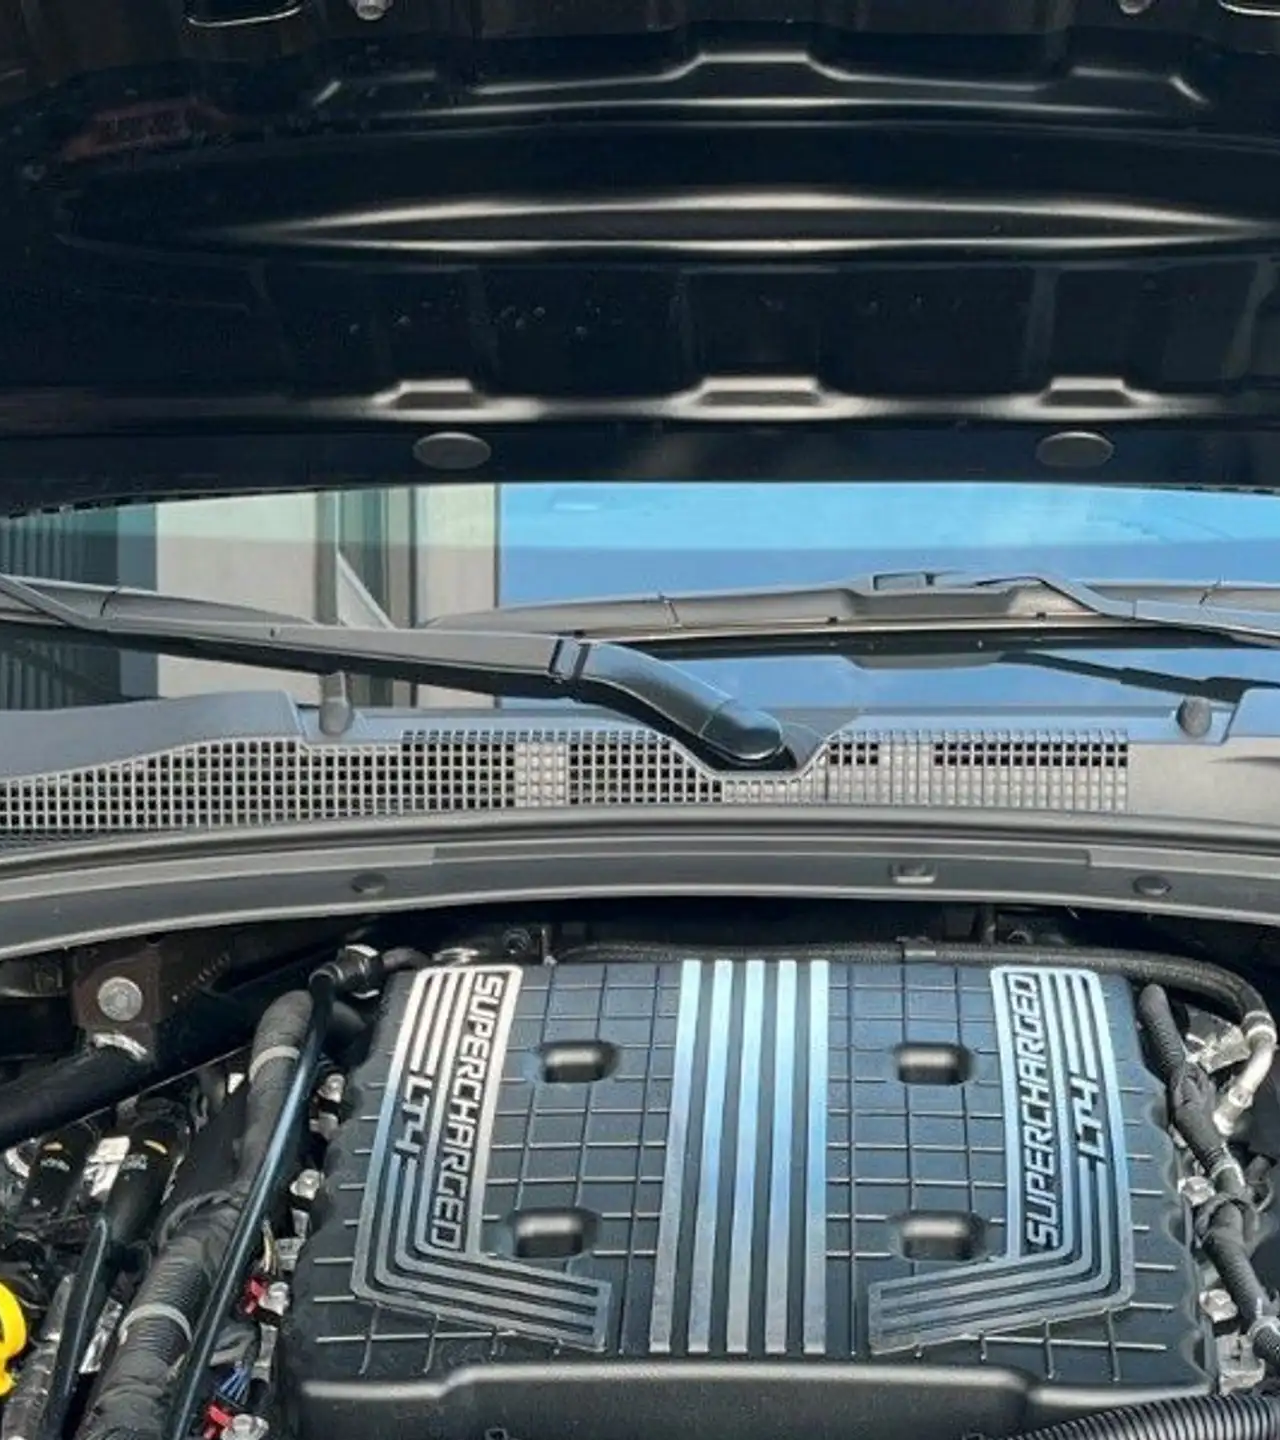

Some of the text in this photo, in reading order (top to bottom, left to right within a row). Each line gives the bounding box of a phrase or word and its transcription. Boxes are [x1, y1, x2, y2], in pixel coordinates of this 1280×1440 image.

[395, 1076, 432, 1153] LT4
[432, 974, 503, 1249] SUPERCHARGED
[1007, 974, 1059, 1249] SUPERCHARGED
[1071, 1078, 1105, 1160] LT4
